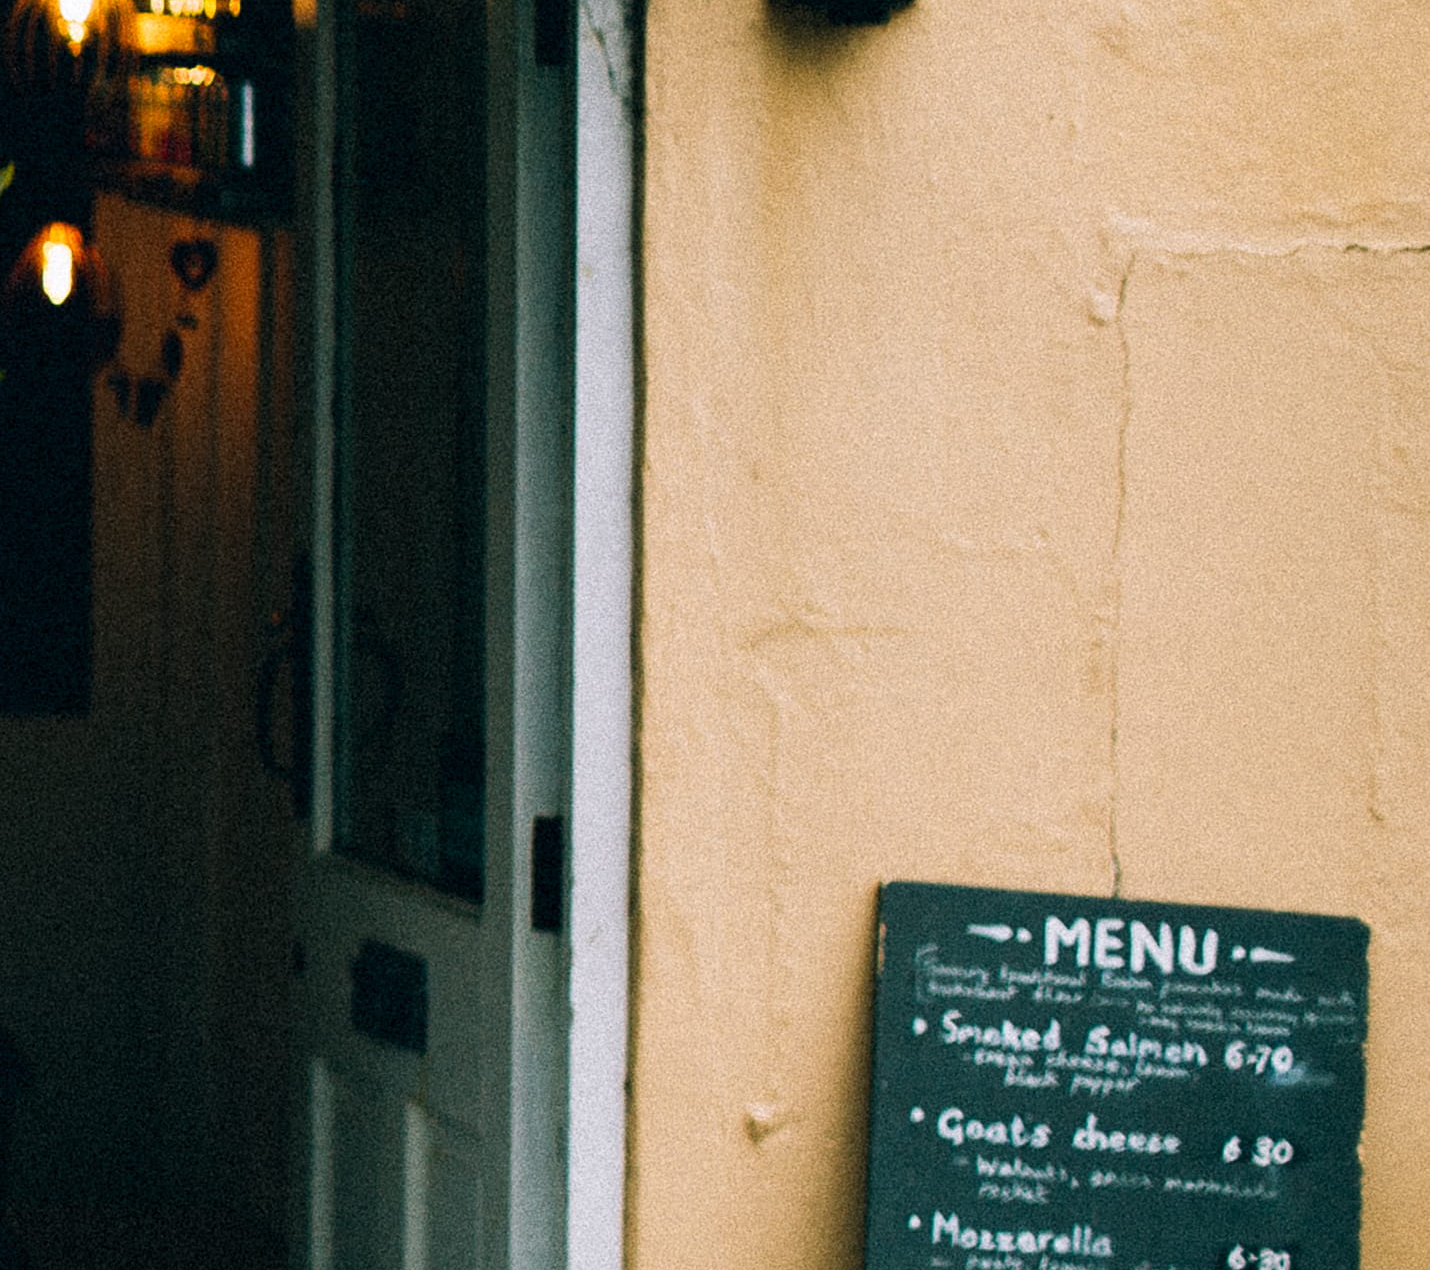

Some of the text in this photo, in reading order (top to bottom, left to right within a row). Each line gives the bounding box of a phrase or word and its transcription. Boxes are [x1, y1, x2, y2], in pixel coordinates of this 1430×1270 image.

[1045, 915, 1218, 975] MENU
[941, 1009, 1060, 1051] Smoked
[1085, 1025, 1208, 1067] Salmon
[937, 1106, 1051, 1148] Goats
[1072, 1112, 1180, 1154] cheese
[932, 1210, 1113, 1257] Mozzarella
